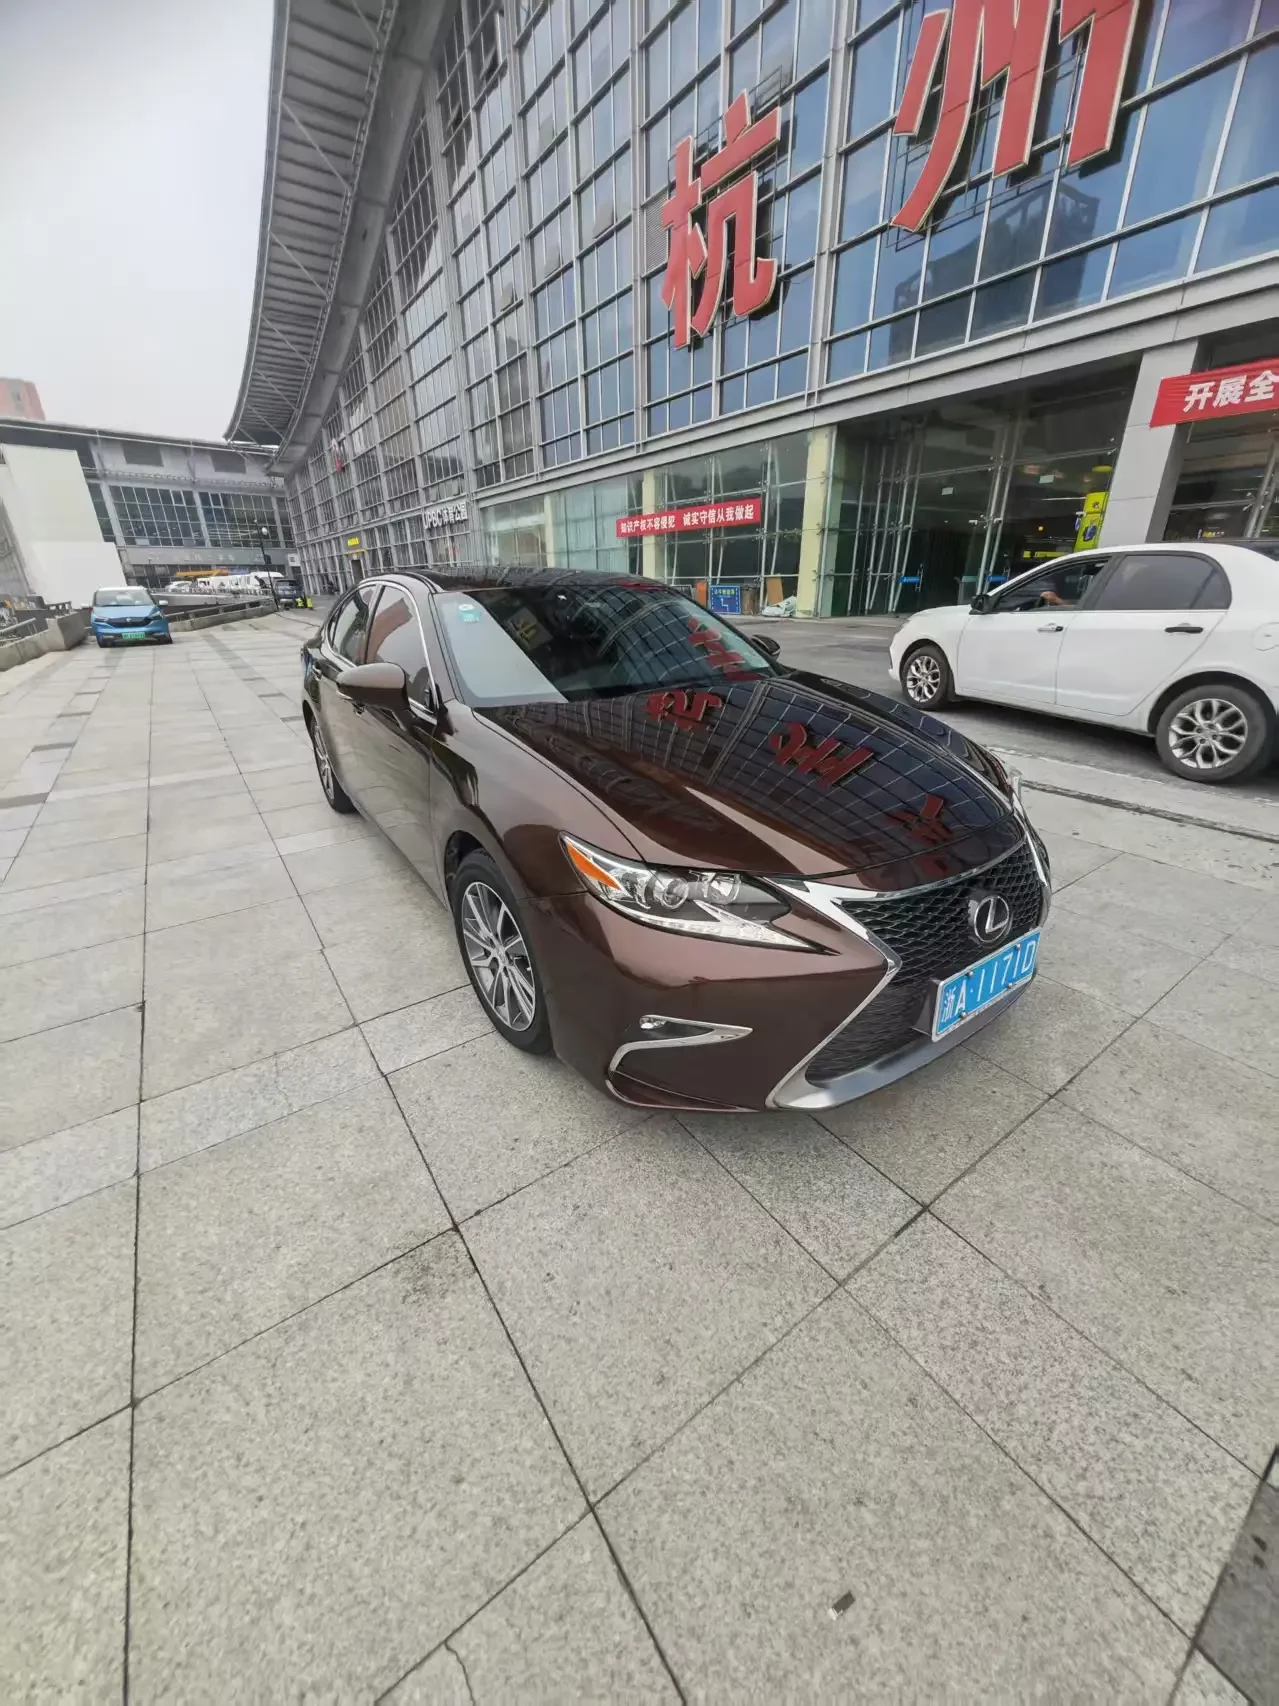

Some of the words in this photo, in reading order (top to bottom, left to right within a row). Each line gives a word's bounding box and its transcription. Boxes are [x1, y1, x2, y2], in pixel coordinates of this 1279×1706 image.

[1183, 370, 1279, 412] 开展全
[620, 516, 675, 533] 知识产权不容侵犯
[683, 504, 754, 526] 诚实守信从我做起
